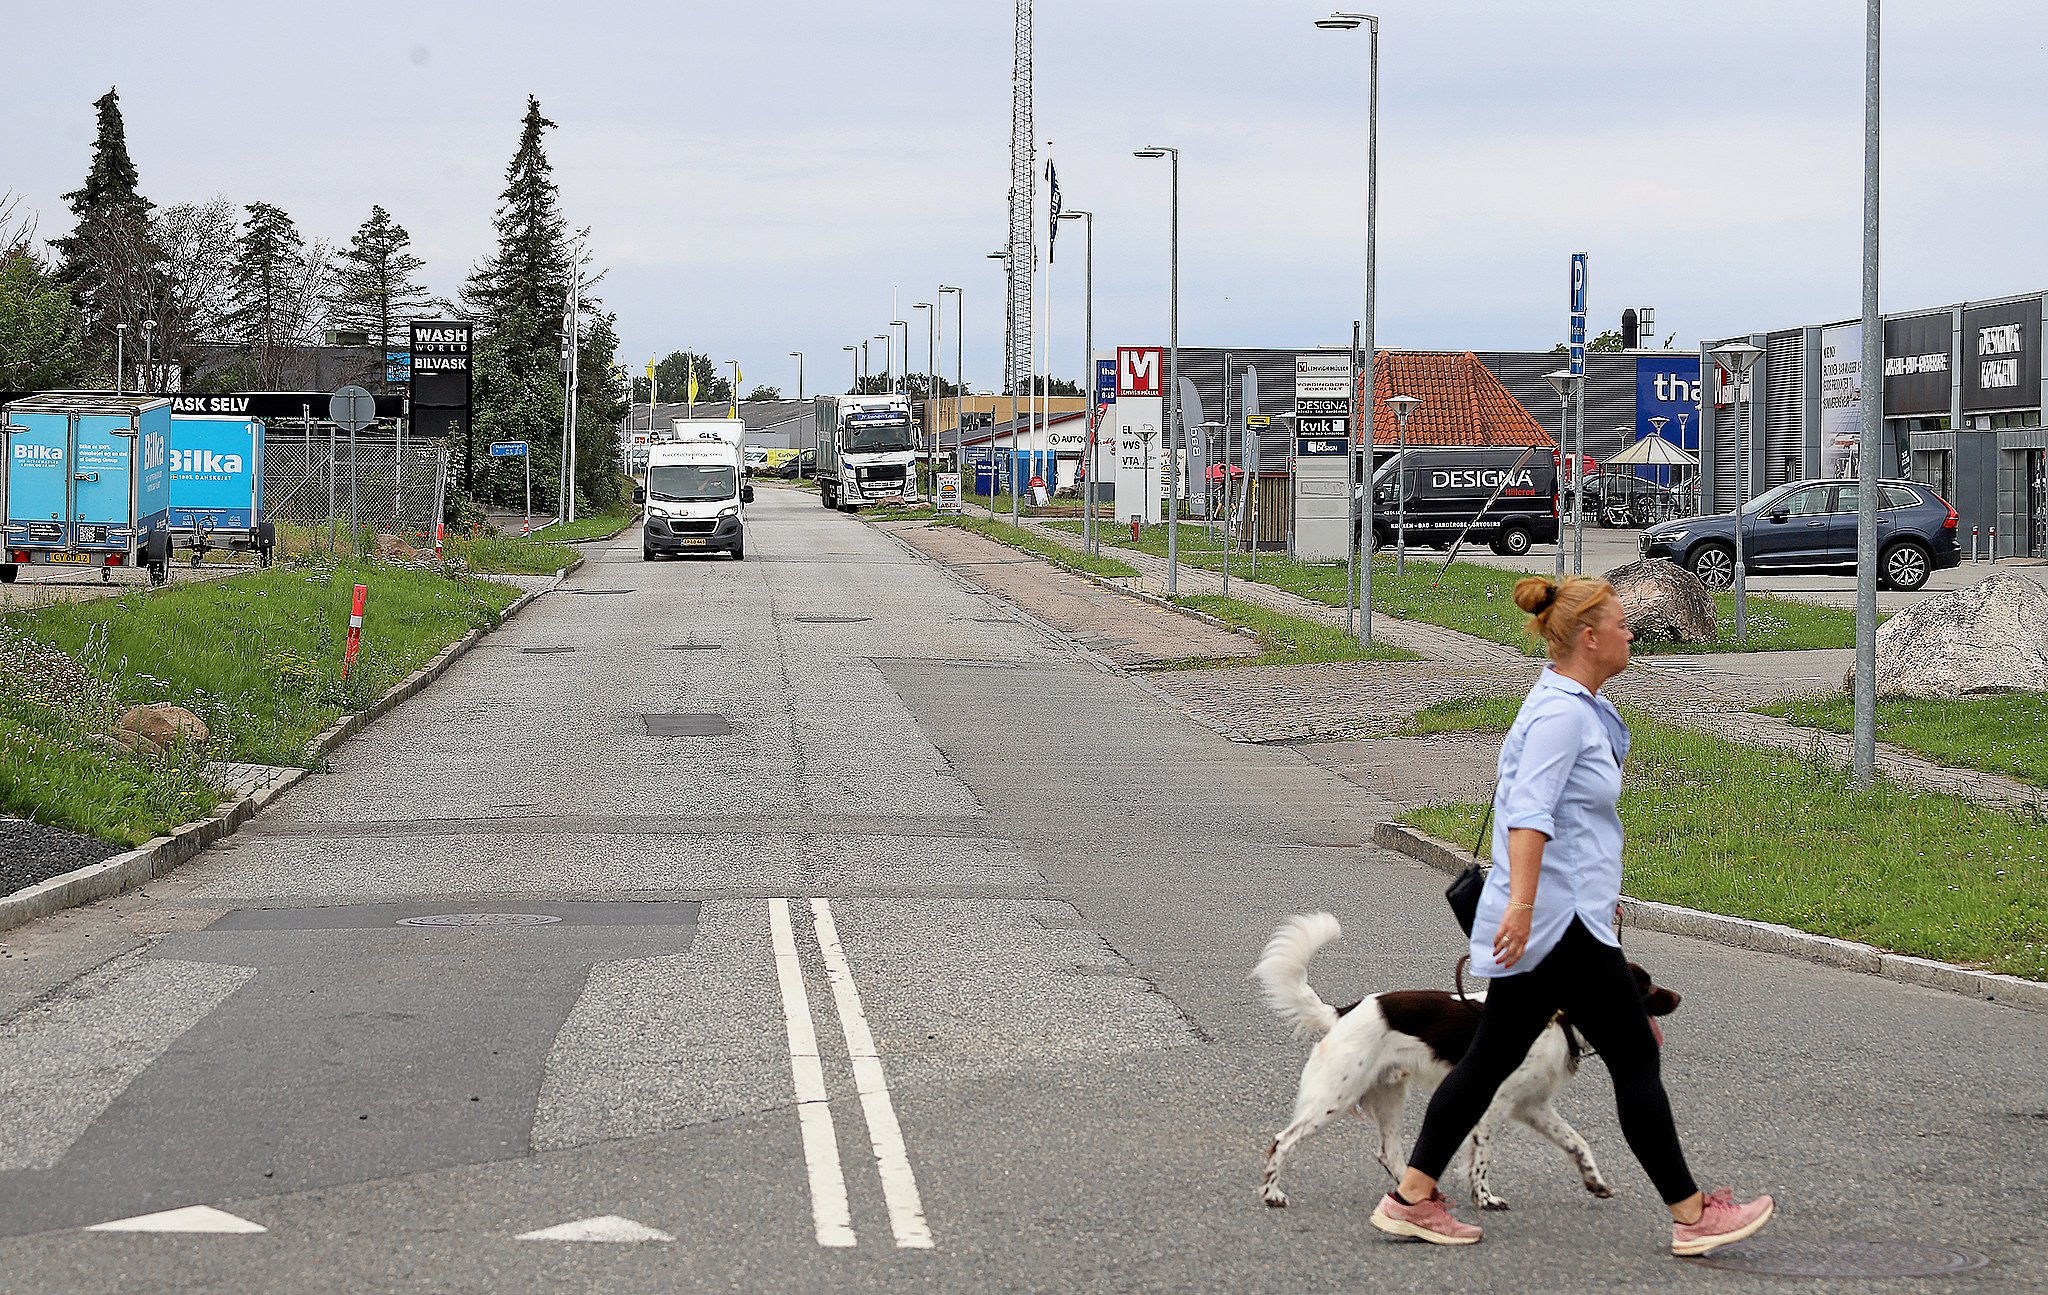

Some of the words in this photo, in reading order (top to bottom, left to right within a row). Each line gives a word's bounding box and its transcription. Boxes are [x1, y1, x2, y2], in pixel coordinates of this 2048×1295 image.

[1573, 260, 1584, 307] P
[415, 328, 468, 342] WASH
[415, 344, 468, 352] WORLD
[414, 358, 467, 370] BILVASK
[210, 397, 250, 412] SELV
[244, 424, 252, 435] 1
[1122, 425, 1132, 434] EL
[1300, 419, 1331, 432] kvik
[144, 431, 165, 470] Bilka
[1122, 440, 1140, 450] VVS
[14, 444, 63, 460] Bilka
[170, 449, 243, 473] Bilka
[1122, 457, 1140, 466] VTA
[1432, 470, 1534, 488] DESIGNA
